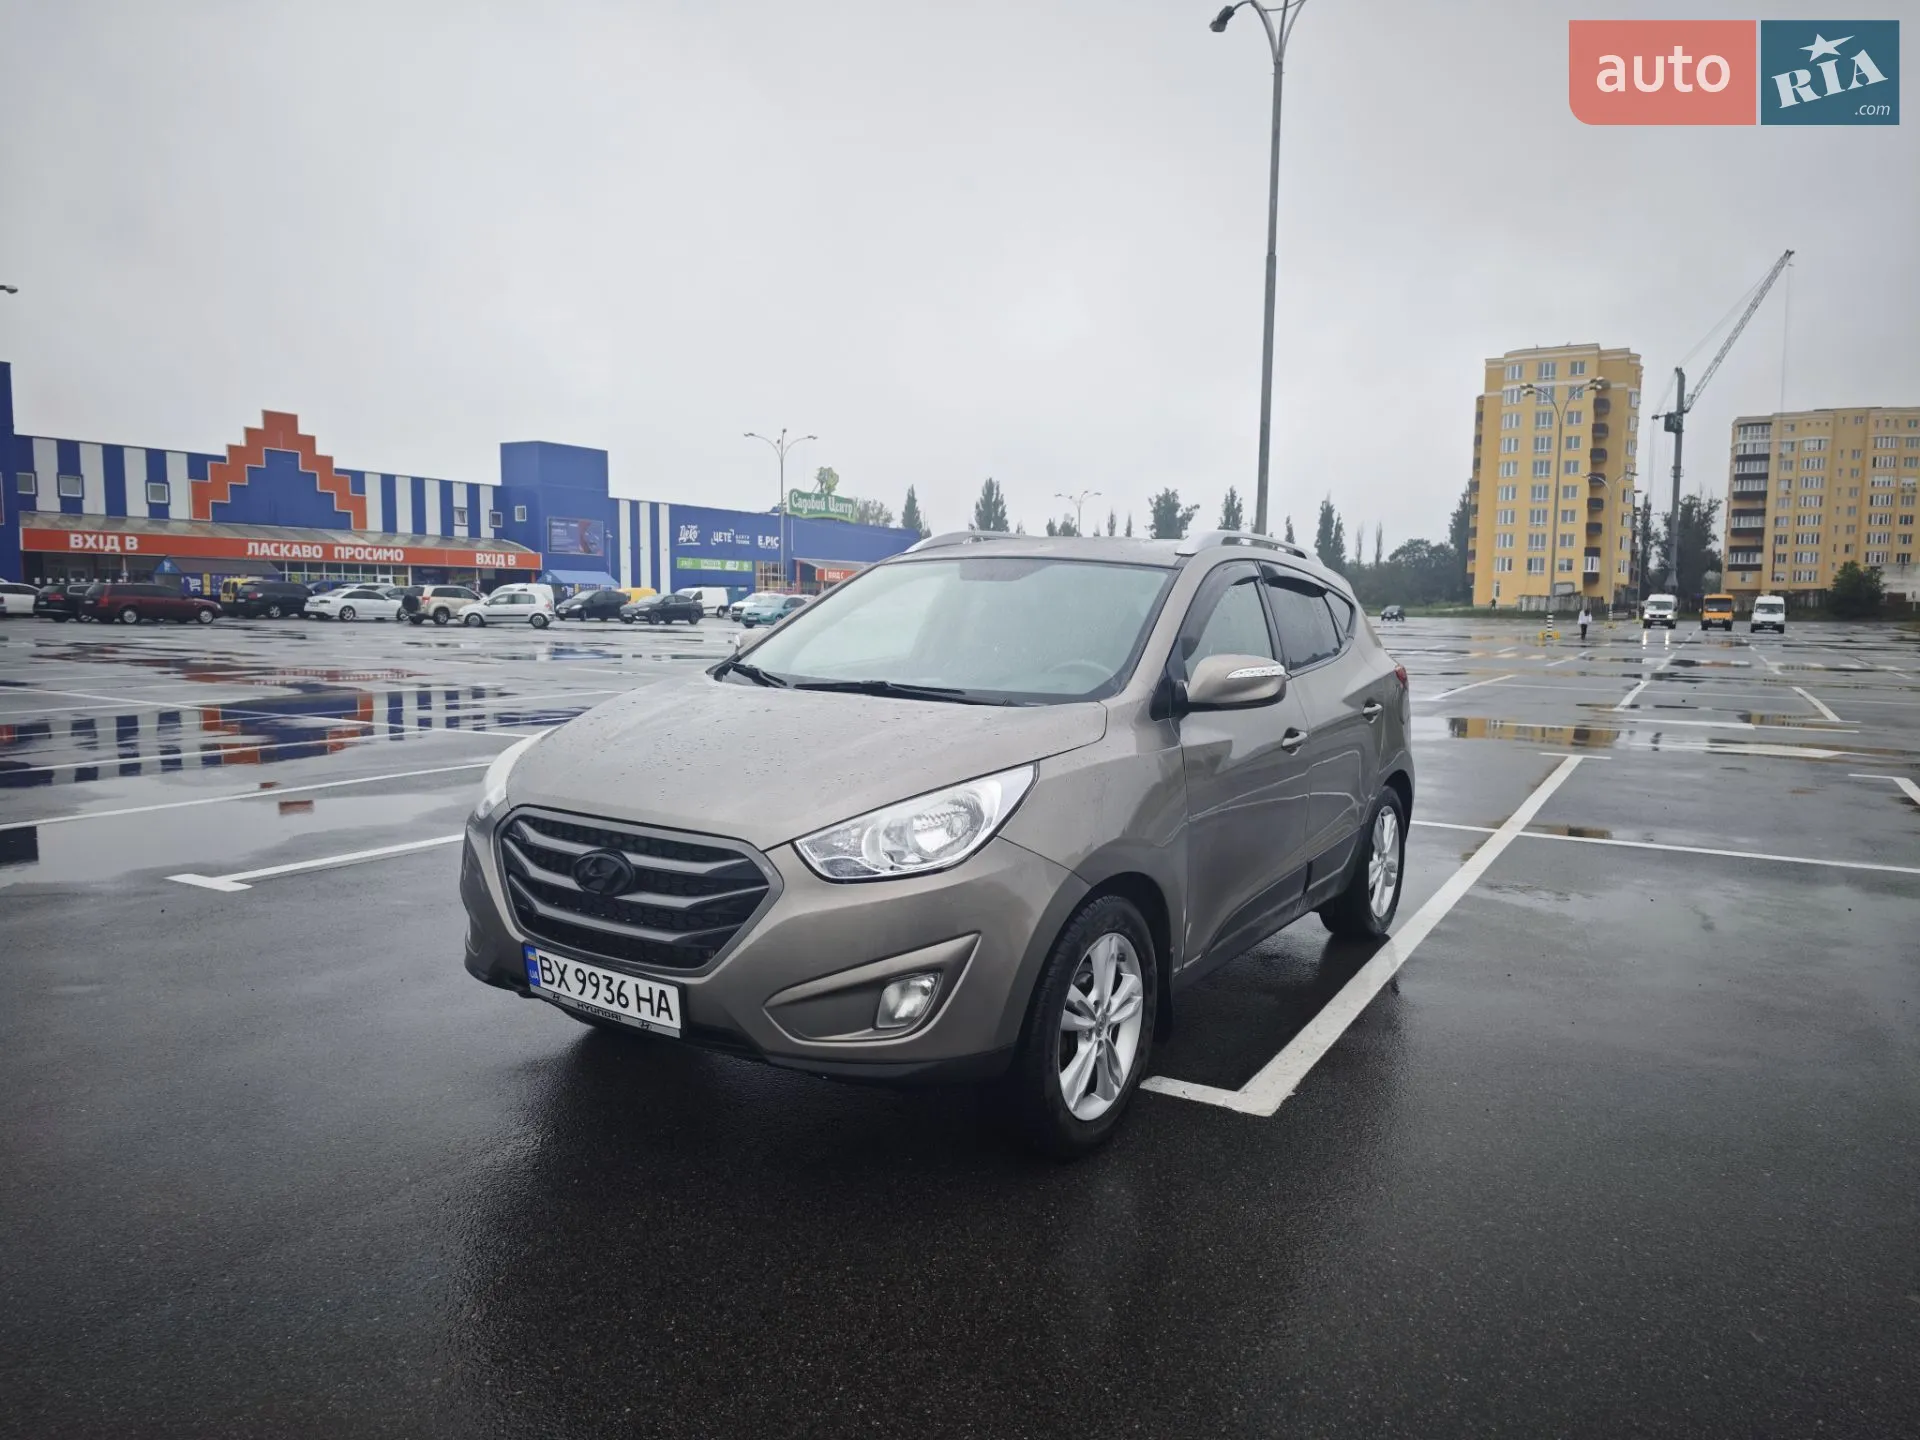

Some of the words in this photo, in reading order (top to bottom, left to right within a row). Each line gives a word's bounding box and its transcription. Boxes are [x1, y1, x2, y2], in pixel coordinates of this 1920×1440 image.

[69, 533, 121, 552] ВХІД
[125, 535, 138, 551] В
[247, 542, 323, 559] ЛАСКАВО
[334, 545, 404, 563] ПРОСИМО
[475, 551, 503, 568] ВХІД
[504, 553, 517, 567] В
[539, 954, 571, 992] BX
[575, 967, 630, 1009] 9936
[635, 983, 674, 1021] HA
[576, 1002, 622, 1022] HYUNDAI
